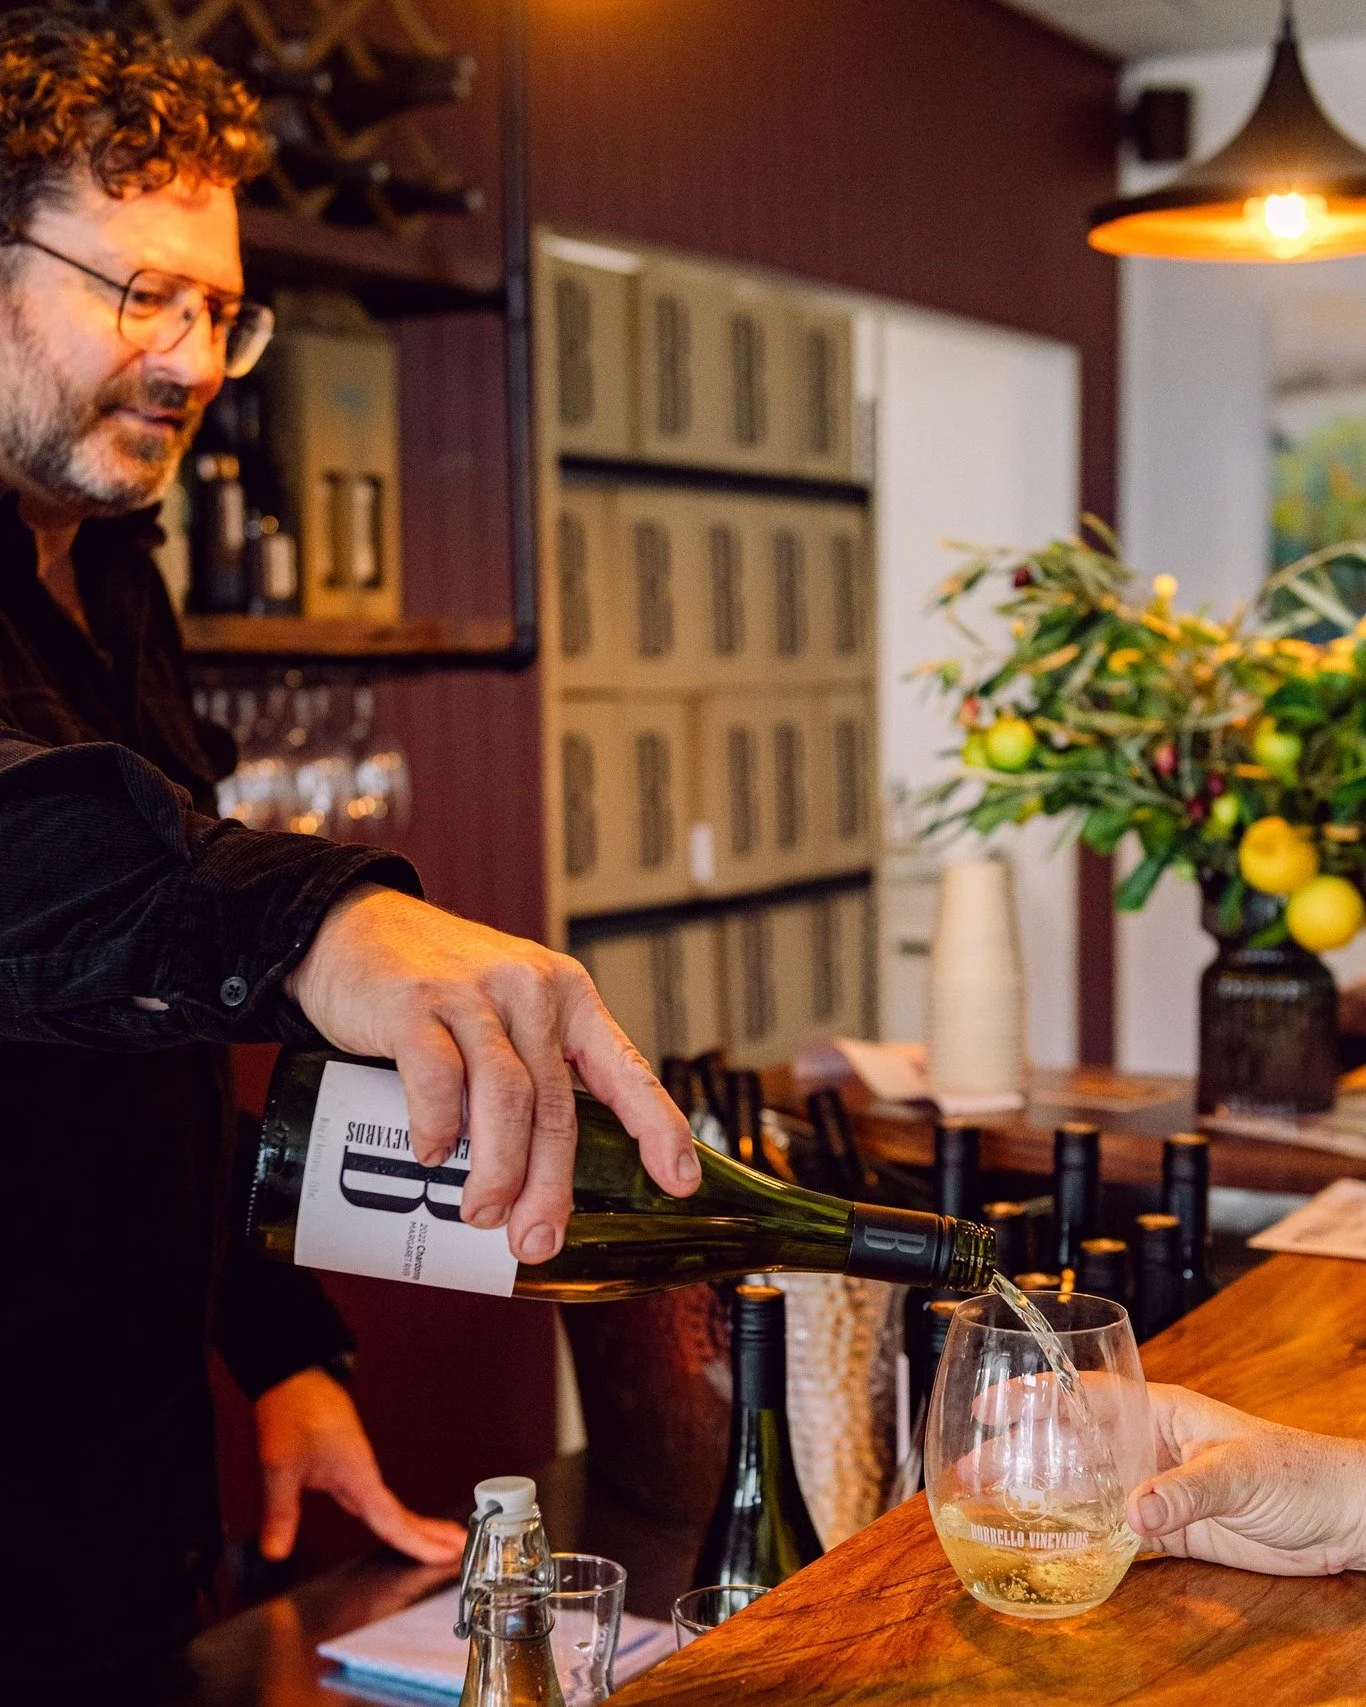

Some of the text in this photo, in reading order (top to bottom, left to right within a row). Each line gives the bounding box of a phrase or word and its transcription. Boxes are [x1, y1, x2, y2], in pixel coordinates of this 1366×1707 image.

[346, 1121, 411, 1151] NEYARDS
[864, 1225, 928, 1255] B
[412, 1245, 426, 1281] Chardonna
[970, 1523, 1090, 1549] BORRELLO VINEYARDS
